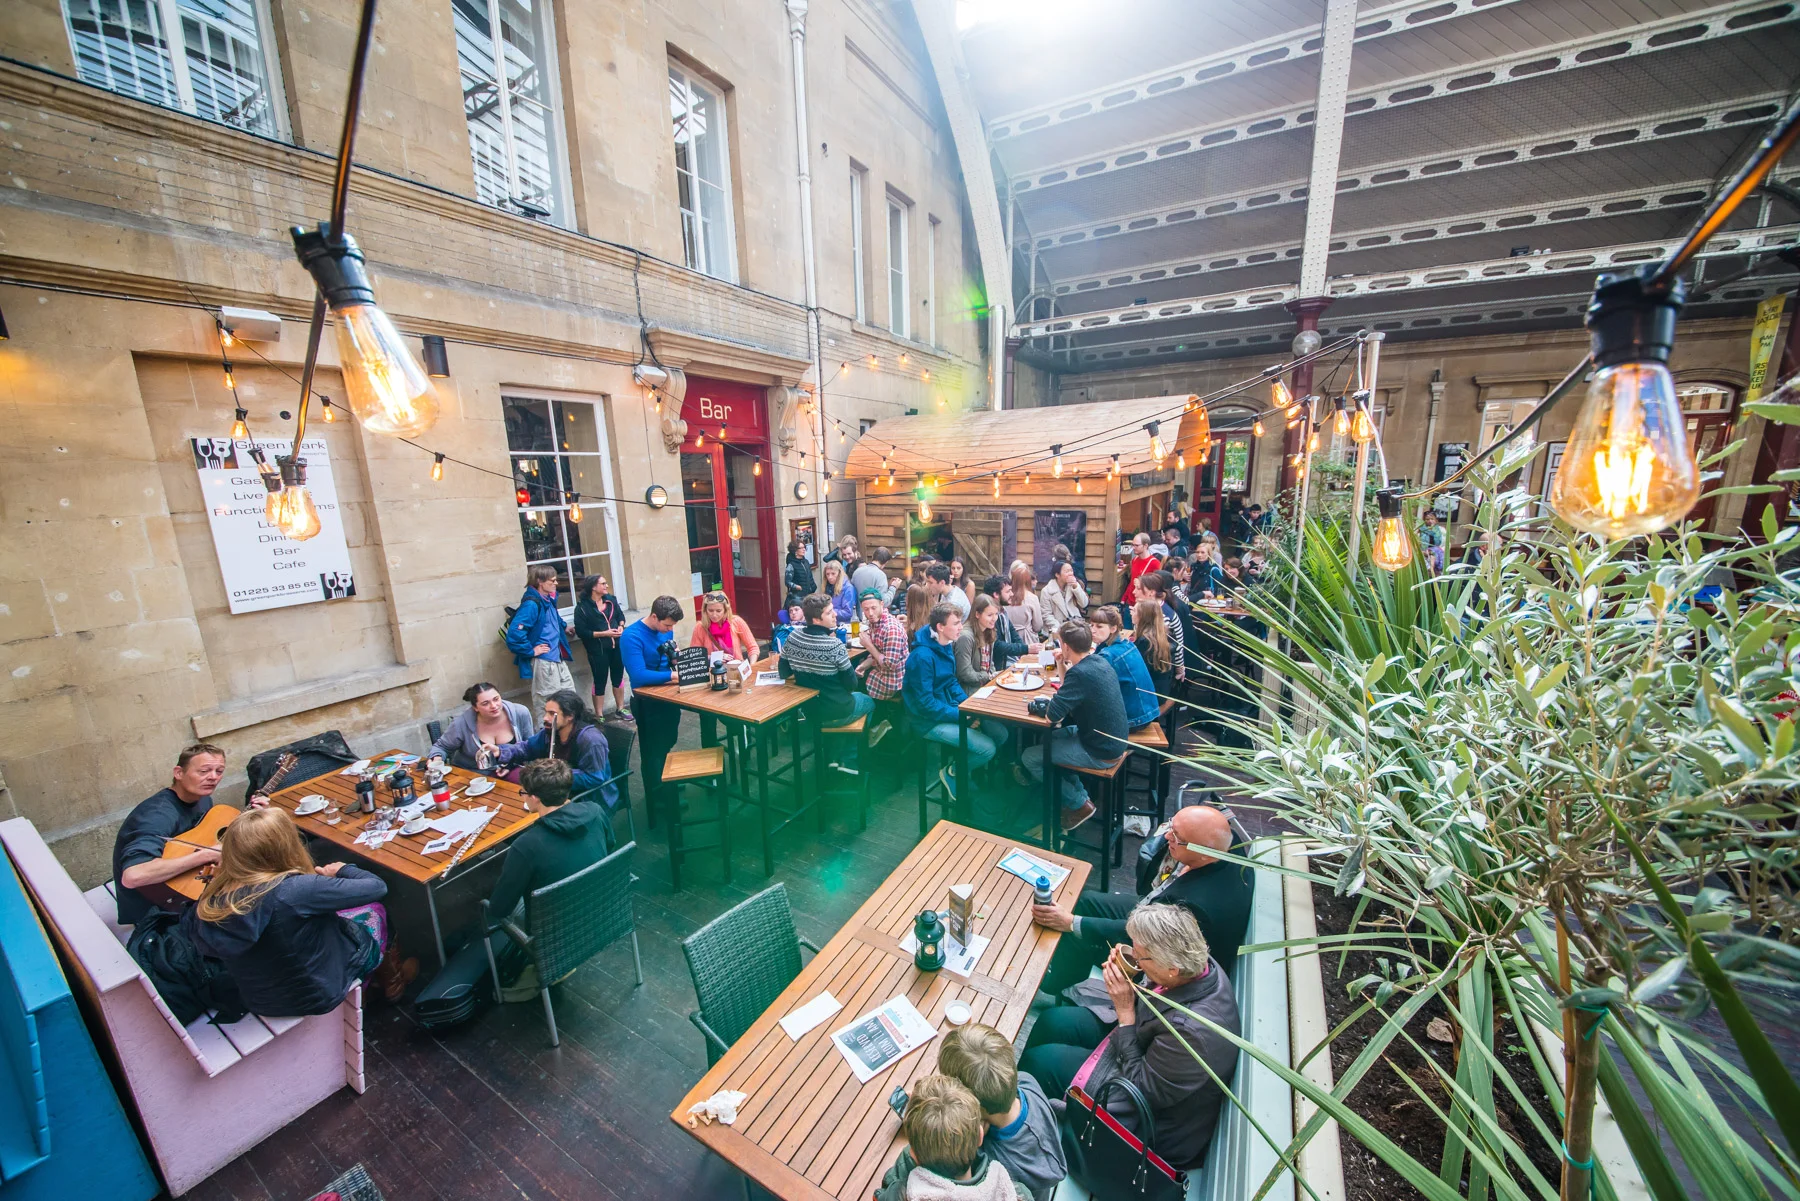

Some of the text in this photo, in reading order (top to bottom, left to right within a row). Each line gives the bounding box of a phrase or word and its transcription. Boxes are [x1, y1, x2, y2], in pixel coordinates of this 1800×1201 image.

[700, 397, 732, 420] Bar
[235, 441, 285, 449] Green
[233, 492, 263, 501] Live
[213, 506, 266, 517] Functi
[273, 547, 301, 556] Bar
[273, 561, 306, 570] Cafe
[233, 580, 317, 597] 01225 33 85 65
[879, 1037, 899, 1058] FROM
